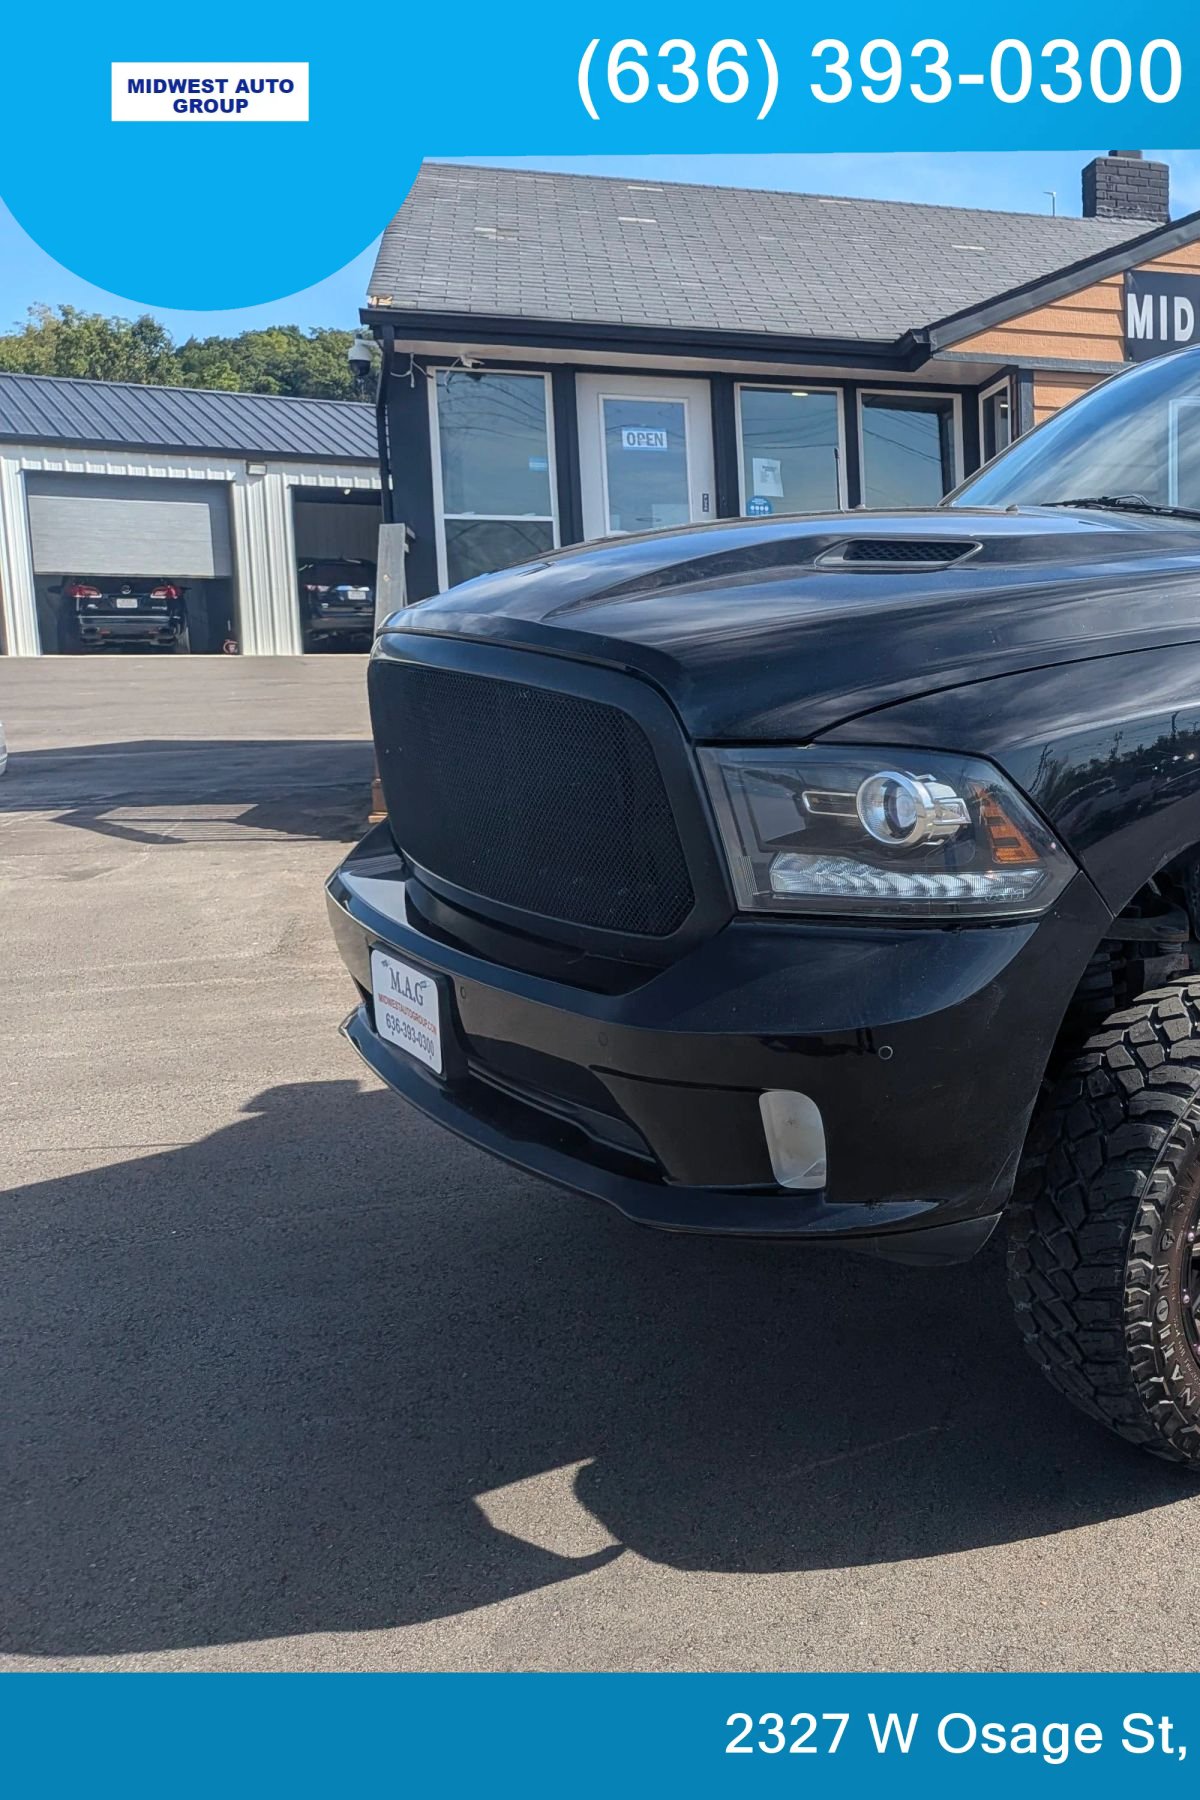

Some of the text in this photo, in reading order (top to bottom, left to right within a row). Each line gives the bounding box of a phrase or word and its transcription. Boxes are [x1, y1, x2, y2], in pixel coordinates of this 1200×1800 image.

[626, 432, 664, 446] OPEN
[389, 967, 424, 1006] M.A.G
[385, 1013, 435, 1057] 636-393-0300
